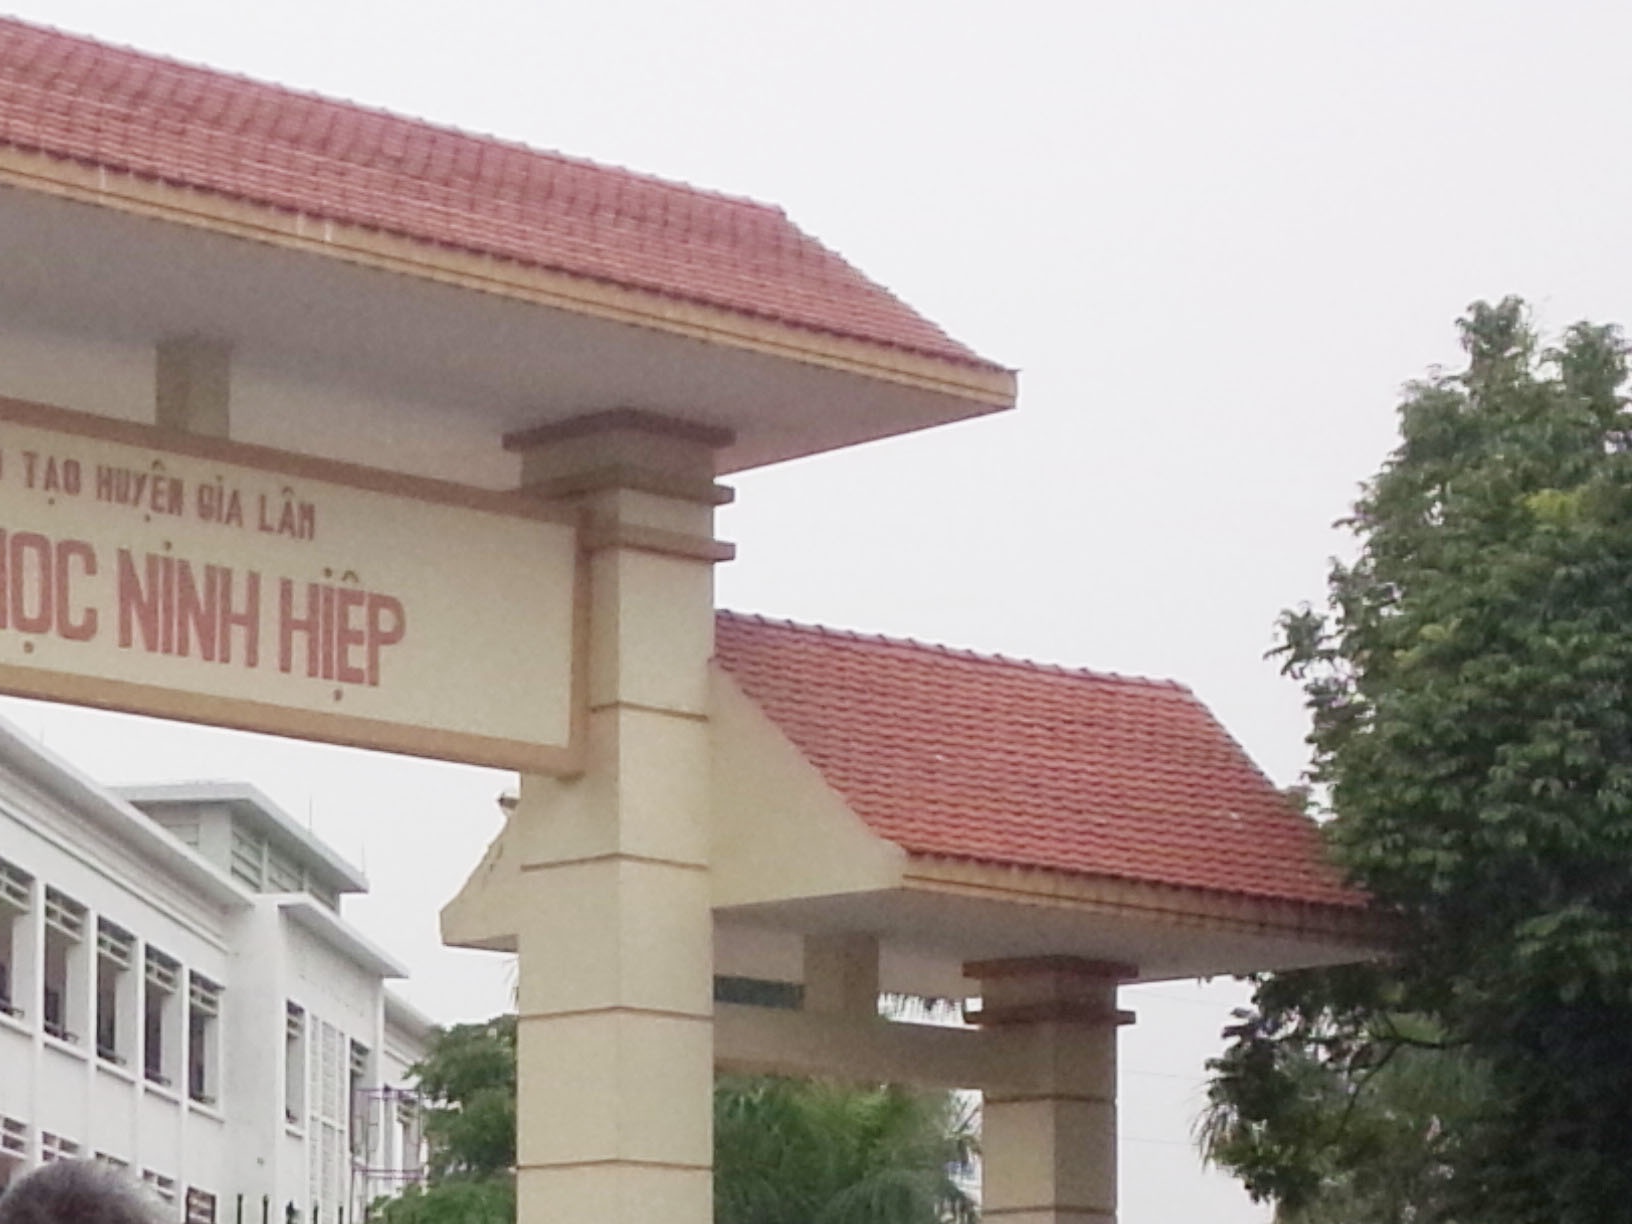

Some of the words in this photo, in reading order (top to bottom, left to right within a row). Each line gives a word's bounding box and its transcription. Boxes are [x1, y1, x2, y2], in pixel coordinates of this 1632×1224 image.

[22, 451, 81, 506] TẠO
[96, 459, 185, 523] HUYỆN
[197, 474, 244, 529] GIA
[257, 485, 316, 541] LÂM
[117, 540, 261, 669] NINH
[279, 567, 407, 702] HIỆP
